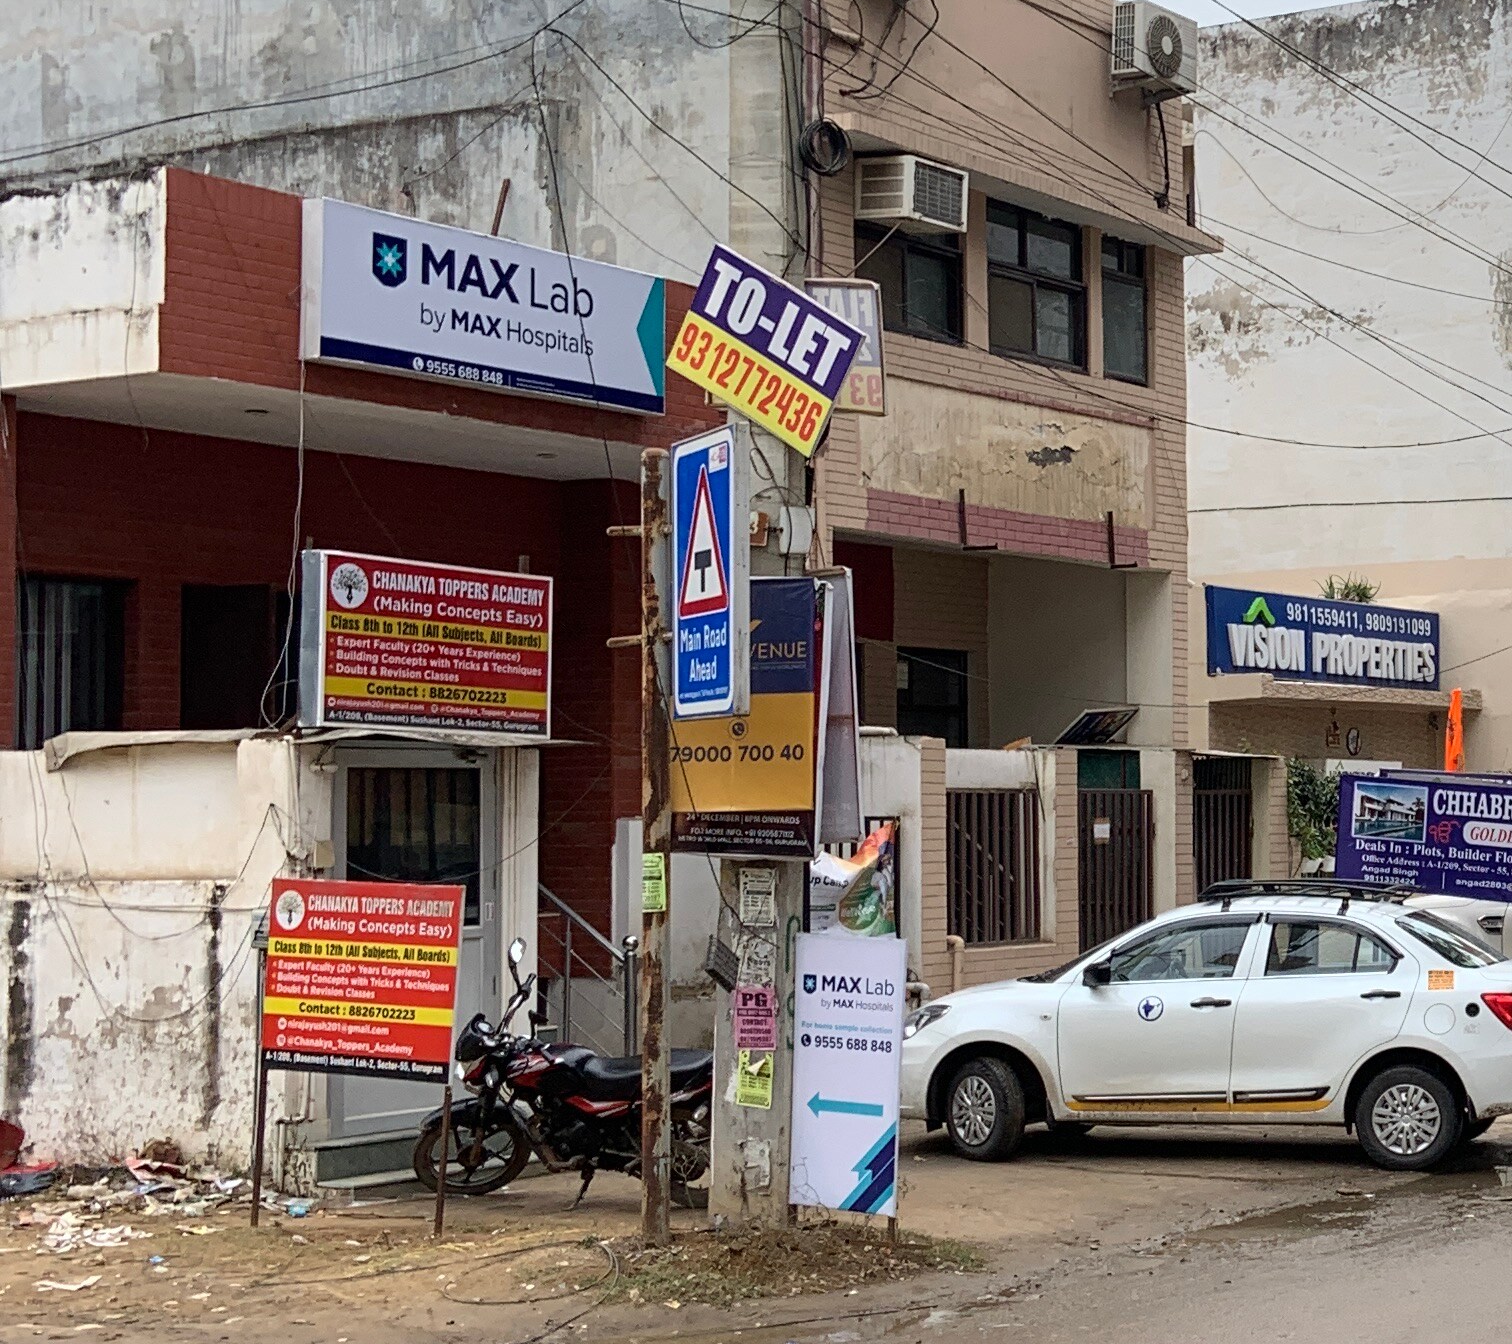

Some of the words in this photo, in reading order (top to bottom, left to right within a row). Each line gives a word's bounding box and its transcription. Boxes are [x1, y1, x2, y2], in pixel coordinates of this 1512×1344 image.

[422, 243, 519, 304] MAX
[531, 267, 593, 318] Lab
[420, 302, 445, 333] by
[451, 309, 501, 339] MAX
[507, 320, 593, 356] Hospitals
[705, 257, 851, 387] TO-LET
[426, 360, 455, 377] 9555
[458, 365, 480, 381] 688
[482, 369, 503, 385] 848
[677, 323, 822, 442] 9312772436
[373, 570, 435, 595] CHANAKYA
[438, 578, 489, 601] TOPPERS
[492, 584, 544, 606] ACADEMY
[373, 596, 432, 617] (Making
[437, 602, 502, 623] Concepts
[506, 610, 543, 628] Easy)
[1286, 602, 1363, 632] 9811559411,
[1366, 613, 1431, 637] 9809191099
[331, 615, 359, 631] Class
[363, 618, 380, 633] 8th
[383, 621, 393, 634] to
[397, 621, 418, 636] 12th
[422, 624, 439, 639] (All
[442, 625, 487, 644] Subjects,
[490, 631, 503, 644] All
[506, 632, 541, 649] Boards)
[680, 628, 701, 653] Main
[704, 621, 726, 649] Road
[337, 636, 370, 650] Expert
[374, 639, 409, 652] Faculty
[413, 643, 435, 654] (20+
[438, 645, 463, 657] Years
[466, 648, 520, 663] Experience)
[1227, 623, 1305, 672] VISION
[1312, 632, 1435, 683] PROPERTIES
[336, 650, 378, 664] Building
[382, 653, 427, 667] Concepts
[430, 656, 450, 669] with
[453, 659, 480, 671] Tricks
[483, 662, 489, 672] &
[492, 663, 542, 677] Techniques
[336, 664, 367, 675] Doubt
[370, 667, 377, 676] &
[380, 667, 421, 679] Revision
[424, 670, 459, 683] Classes
[689, 656, 717, 682] Ahead
[367, 683, 418, 698] Contact
[430, 687, 506, 704] 8826702223
[671, 746, 731, 762] 79000
[739, 745, 774, 762] 700
[780, 744, 804, 761] 40
[701, 814, 739, 822] DECEMBER
[1356, 839, 1386, 852] Deals
[1390, 842, 1402, 854] In
[1413, 844, 1445, 859] Plots,
[1449, 847, 1492, 862] Builder
[1361, 864, 1390, 874] Angad
[1392, 868, 1419, 877] Singh
[1362, 854, 1385, 864] Office
[1387, 858, 1420, 867] Address
[1427, 860, 1461, 871] A-1/209,
[1463, 864, 1489, 873] Sector
[1497, 865, 1510, 876] 55,
[308, 895, 359, 913] CHANAKYA
[361, 897, 404, 916] TOPPERS
[406, 899, 454, 918] ACADEMY
[308, 916, 355, 934] (Making
[359, 920, 415, 937] Concepts
[419, 922, 453, 939] Easy)
[274, 940, 297, 954] Class
[299, 943, 312, 955] 8th
[315, 944, 322, 955] to
[325, 943, 343, 956] 12th
[346, 945, 360, 958] (All
[362, 946, 401, 961] Subjects,
[403, 948, 415, 961] All
[417, 949, 450, 963] Boards)
[278, 960, 304, 972] Expert
[306, 961, 335, 975] Faculty
[337, 963, 356, 975] (20+
[358, 965, 379, 976] Years
[382, 966, 430, 978] Experience)
[276, 983, 300, 994] Doubt
[310, 986, 344, 997] Revision
[345, 988, 375, 1000] Classes
[277, 972, 310, 985] Building
[312, 974, 349, 987] Concepts
[351, 976, 369, 987] with
[371, 977, 394, 988] Tricks
[404, 979, 449, 992] Techniques
[822, 975, 862, 994] MAX
[866, 977, 895, 997] Lab
[299, 1002, 340, 1015] Contact
[349, 1005, 416, 1020] 8826702223
[742, 993, 767, 1007] PG
[821, 998, 831, 1009] by
[833, 999, 854, 1009] MAX
[855, 1000, 893, 1013] Hospitals
[814, 1022, 832, 1031] home
[834, 1023, 858, 1035] sample
[860, 1025, 892, 1035] collection
[815, 1038, 843, 1050] 9555
[846, 1038, 868, 1052] 688
[871, 1039, 892, 1053] 848
